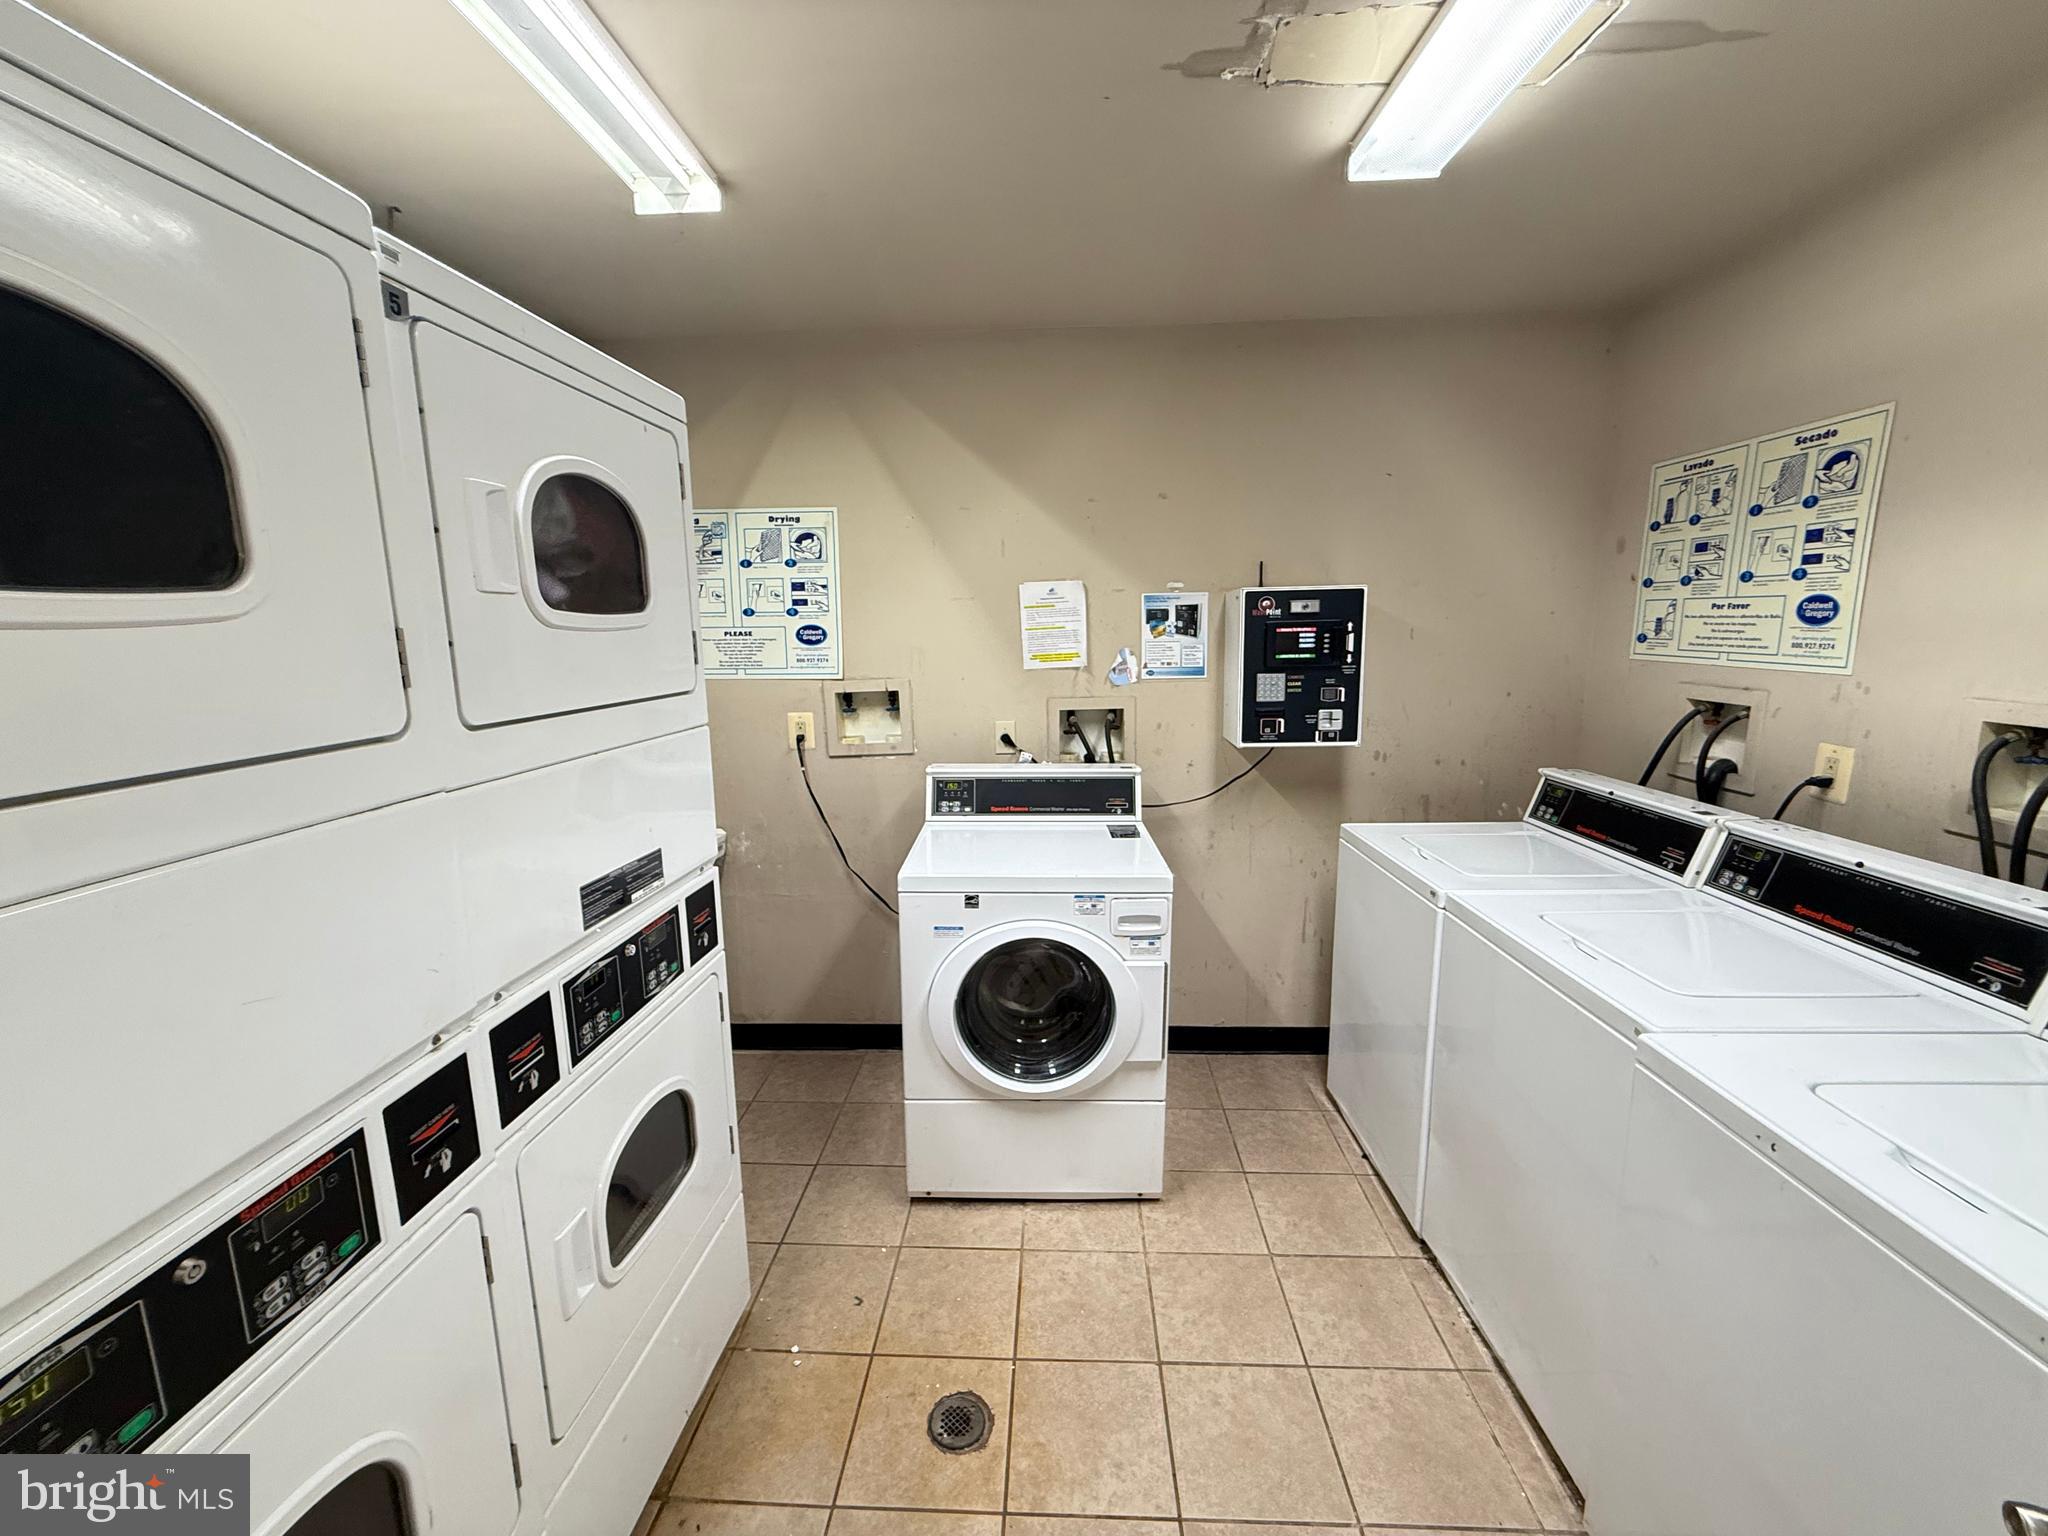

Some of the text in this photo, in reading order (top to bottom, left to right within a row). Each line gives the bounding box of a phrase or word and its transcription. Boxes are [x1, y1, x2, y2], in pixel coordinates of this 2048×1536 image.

[389, 291, 402, 316] 5
[1794, 429, 1838, 446] Secado
[1683, 458, 1715, 472] Lavado
[768, 515, 801, 524] Drying
[1727, 602, 1751, 610] Favor
[1802, 601, 1834, 609] Caldwell
[1805, 609, 1835, 619] Gregory
[1794, 904, 1824, 920] Speed
[1823, 914, 1855, 932] Queen
[1854, 927, 1894, 947] Commercial
[239, 1152, 335, 1223] Speed Queen
[19, 1345, 64, 1382] UPPER
